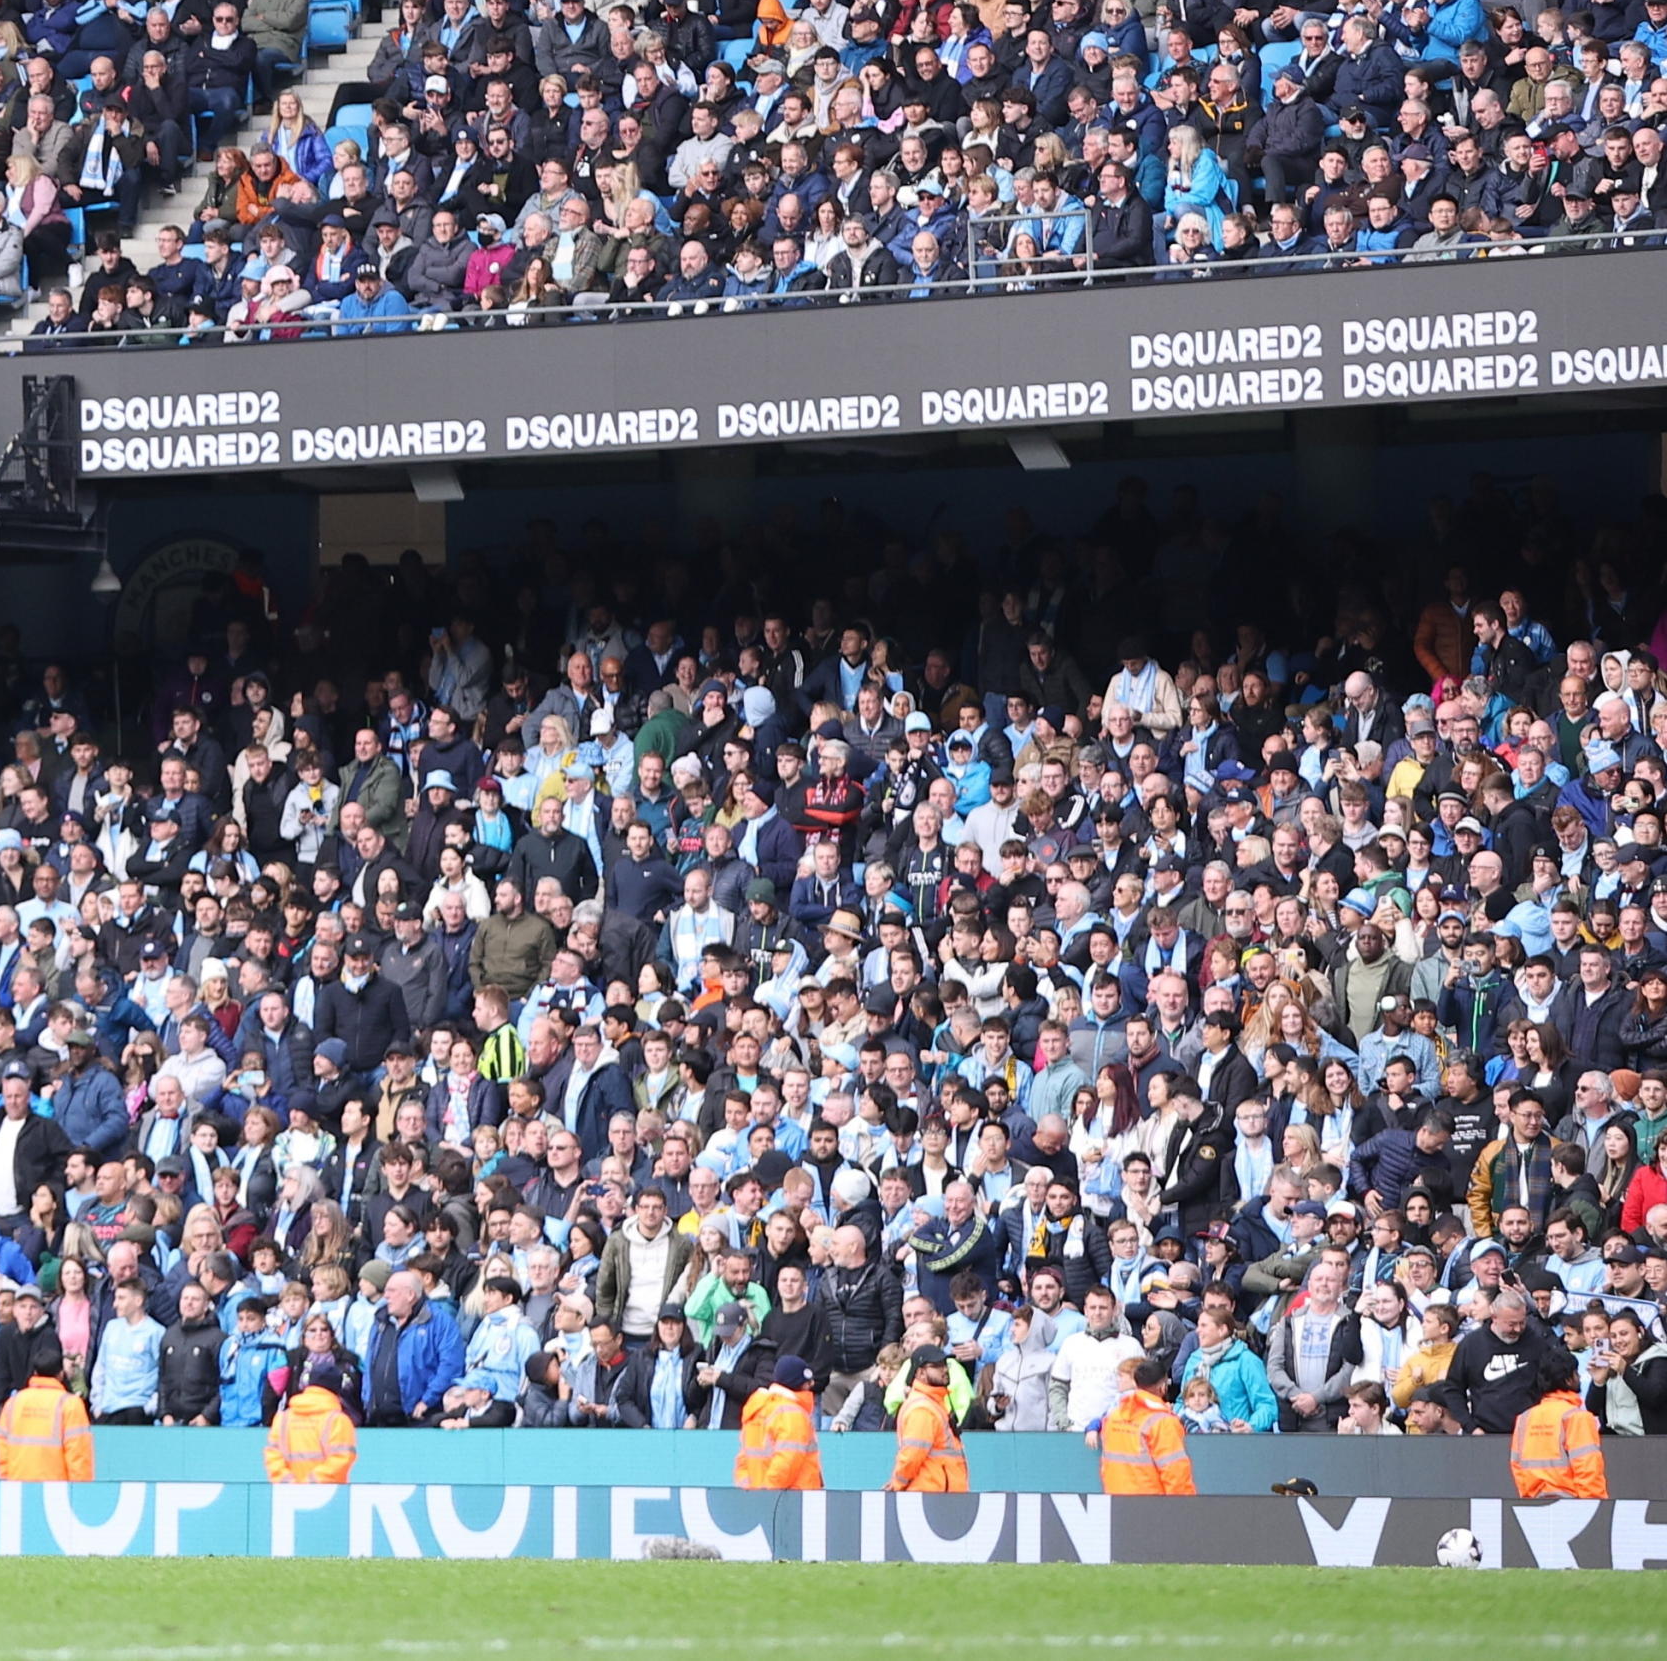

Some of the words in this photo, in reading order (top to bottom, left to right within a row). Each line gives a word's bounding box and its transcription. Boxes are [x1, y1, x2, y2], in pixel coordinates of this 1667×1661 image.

[1131, 325, 1322, 369] DSQUARED2
[1343, 311, 1537, 355] DSQUARED2
[82, 391, 280, 432] DSQUARED2
[82, 432, 280, 472] DSQUARED2
[293, 420, 486, 461] DSQUARED2
[507, 408, 698, 450] DSQUARED2
[718, 395, 899, 438] DSQUARED2
[922, 382, 1108, 425] DSQUARED2
[1132, 367, 1323, 411] DSQUARED2
[1344, 354, 1538, 398] DSQUARED2
